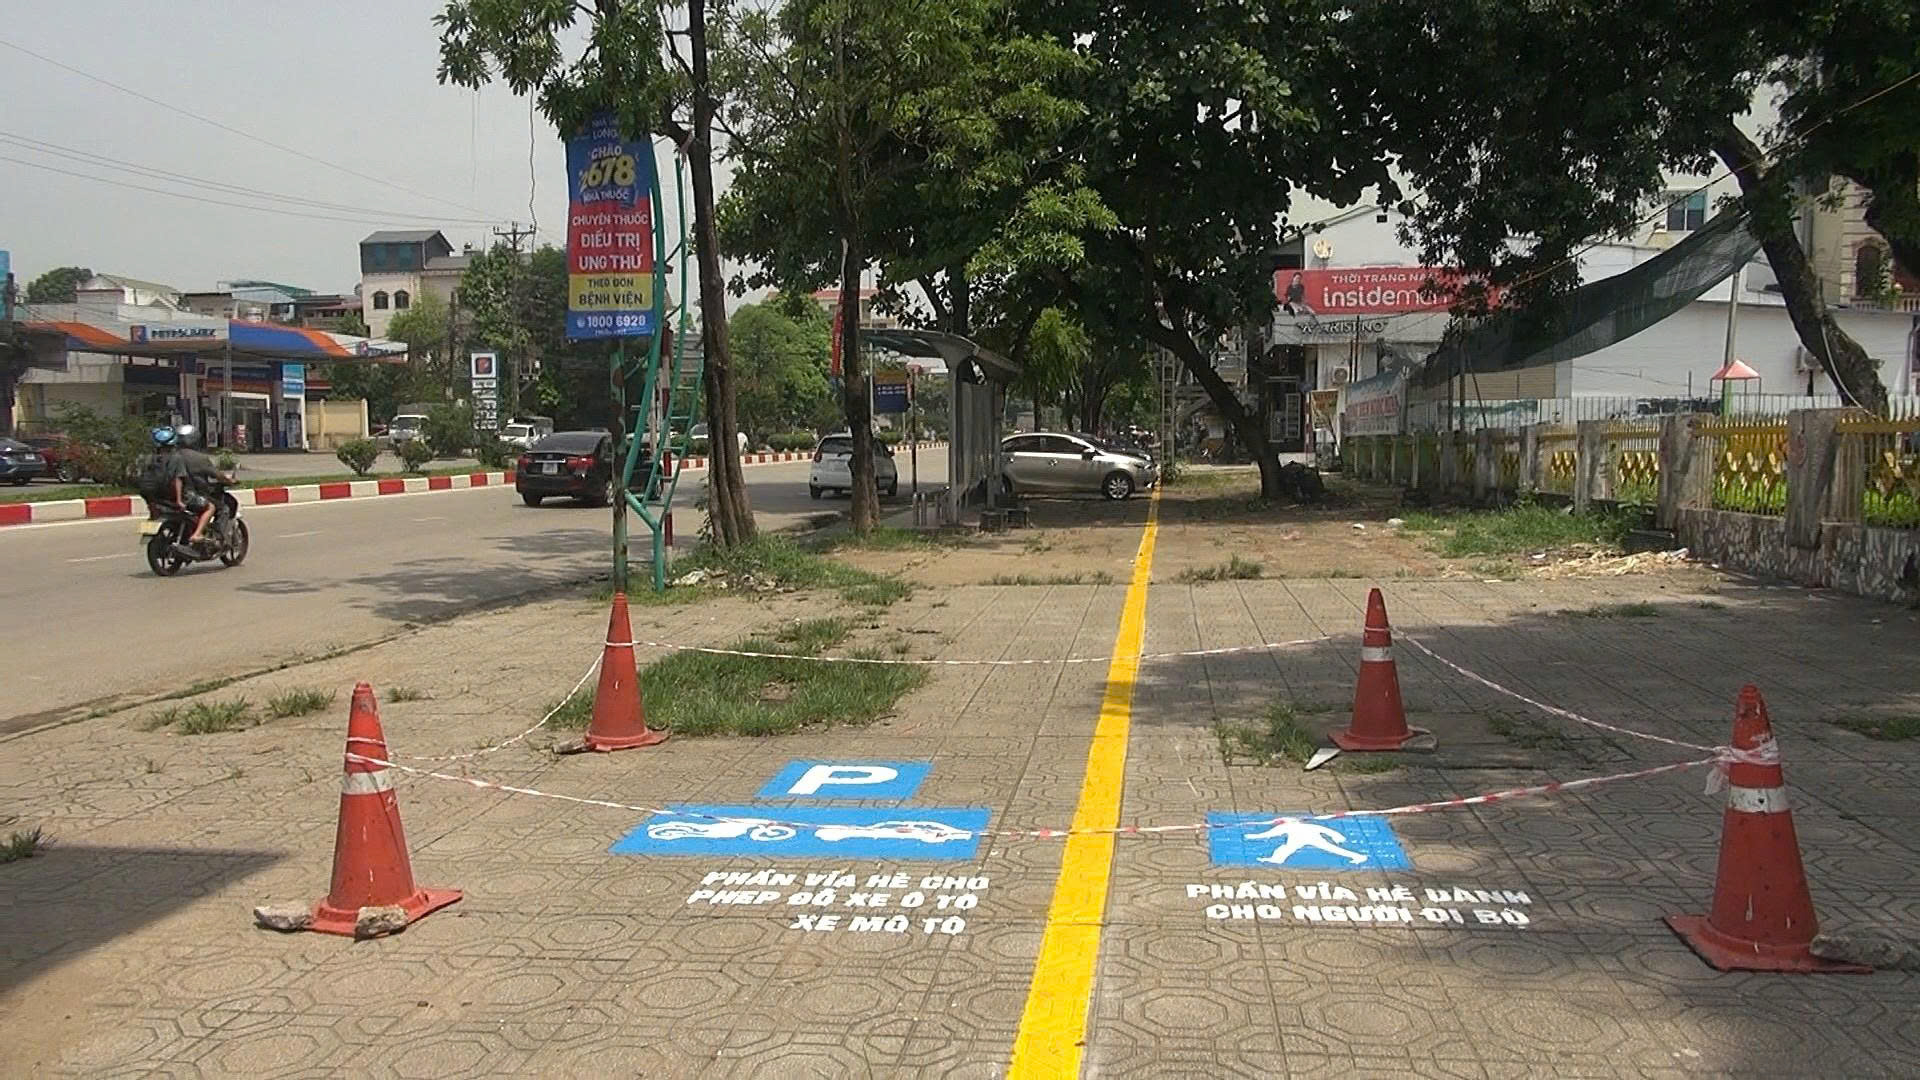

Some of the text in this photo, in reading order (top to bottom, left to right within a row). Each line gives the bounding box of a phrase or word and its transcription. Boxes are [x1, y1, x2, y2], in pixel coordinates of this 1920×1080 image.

[579, 255, 607, 270] UNG
[1364, 274, 1407, 283] TRANG
[787, 764, 898, 795] P
[920, 876, 990, 889] CHO
[844, 893, 892, 908] XE
[1206, 903, 1282, 919] CHO
[789, 914, 842, 932] XE
